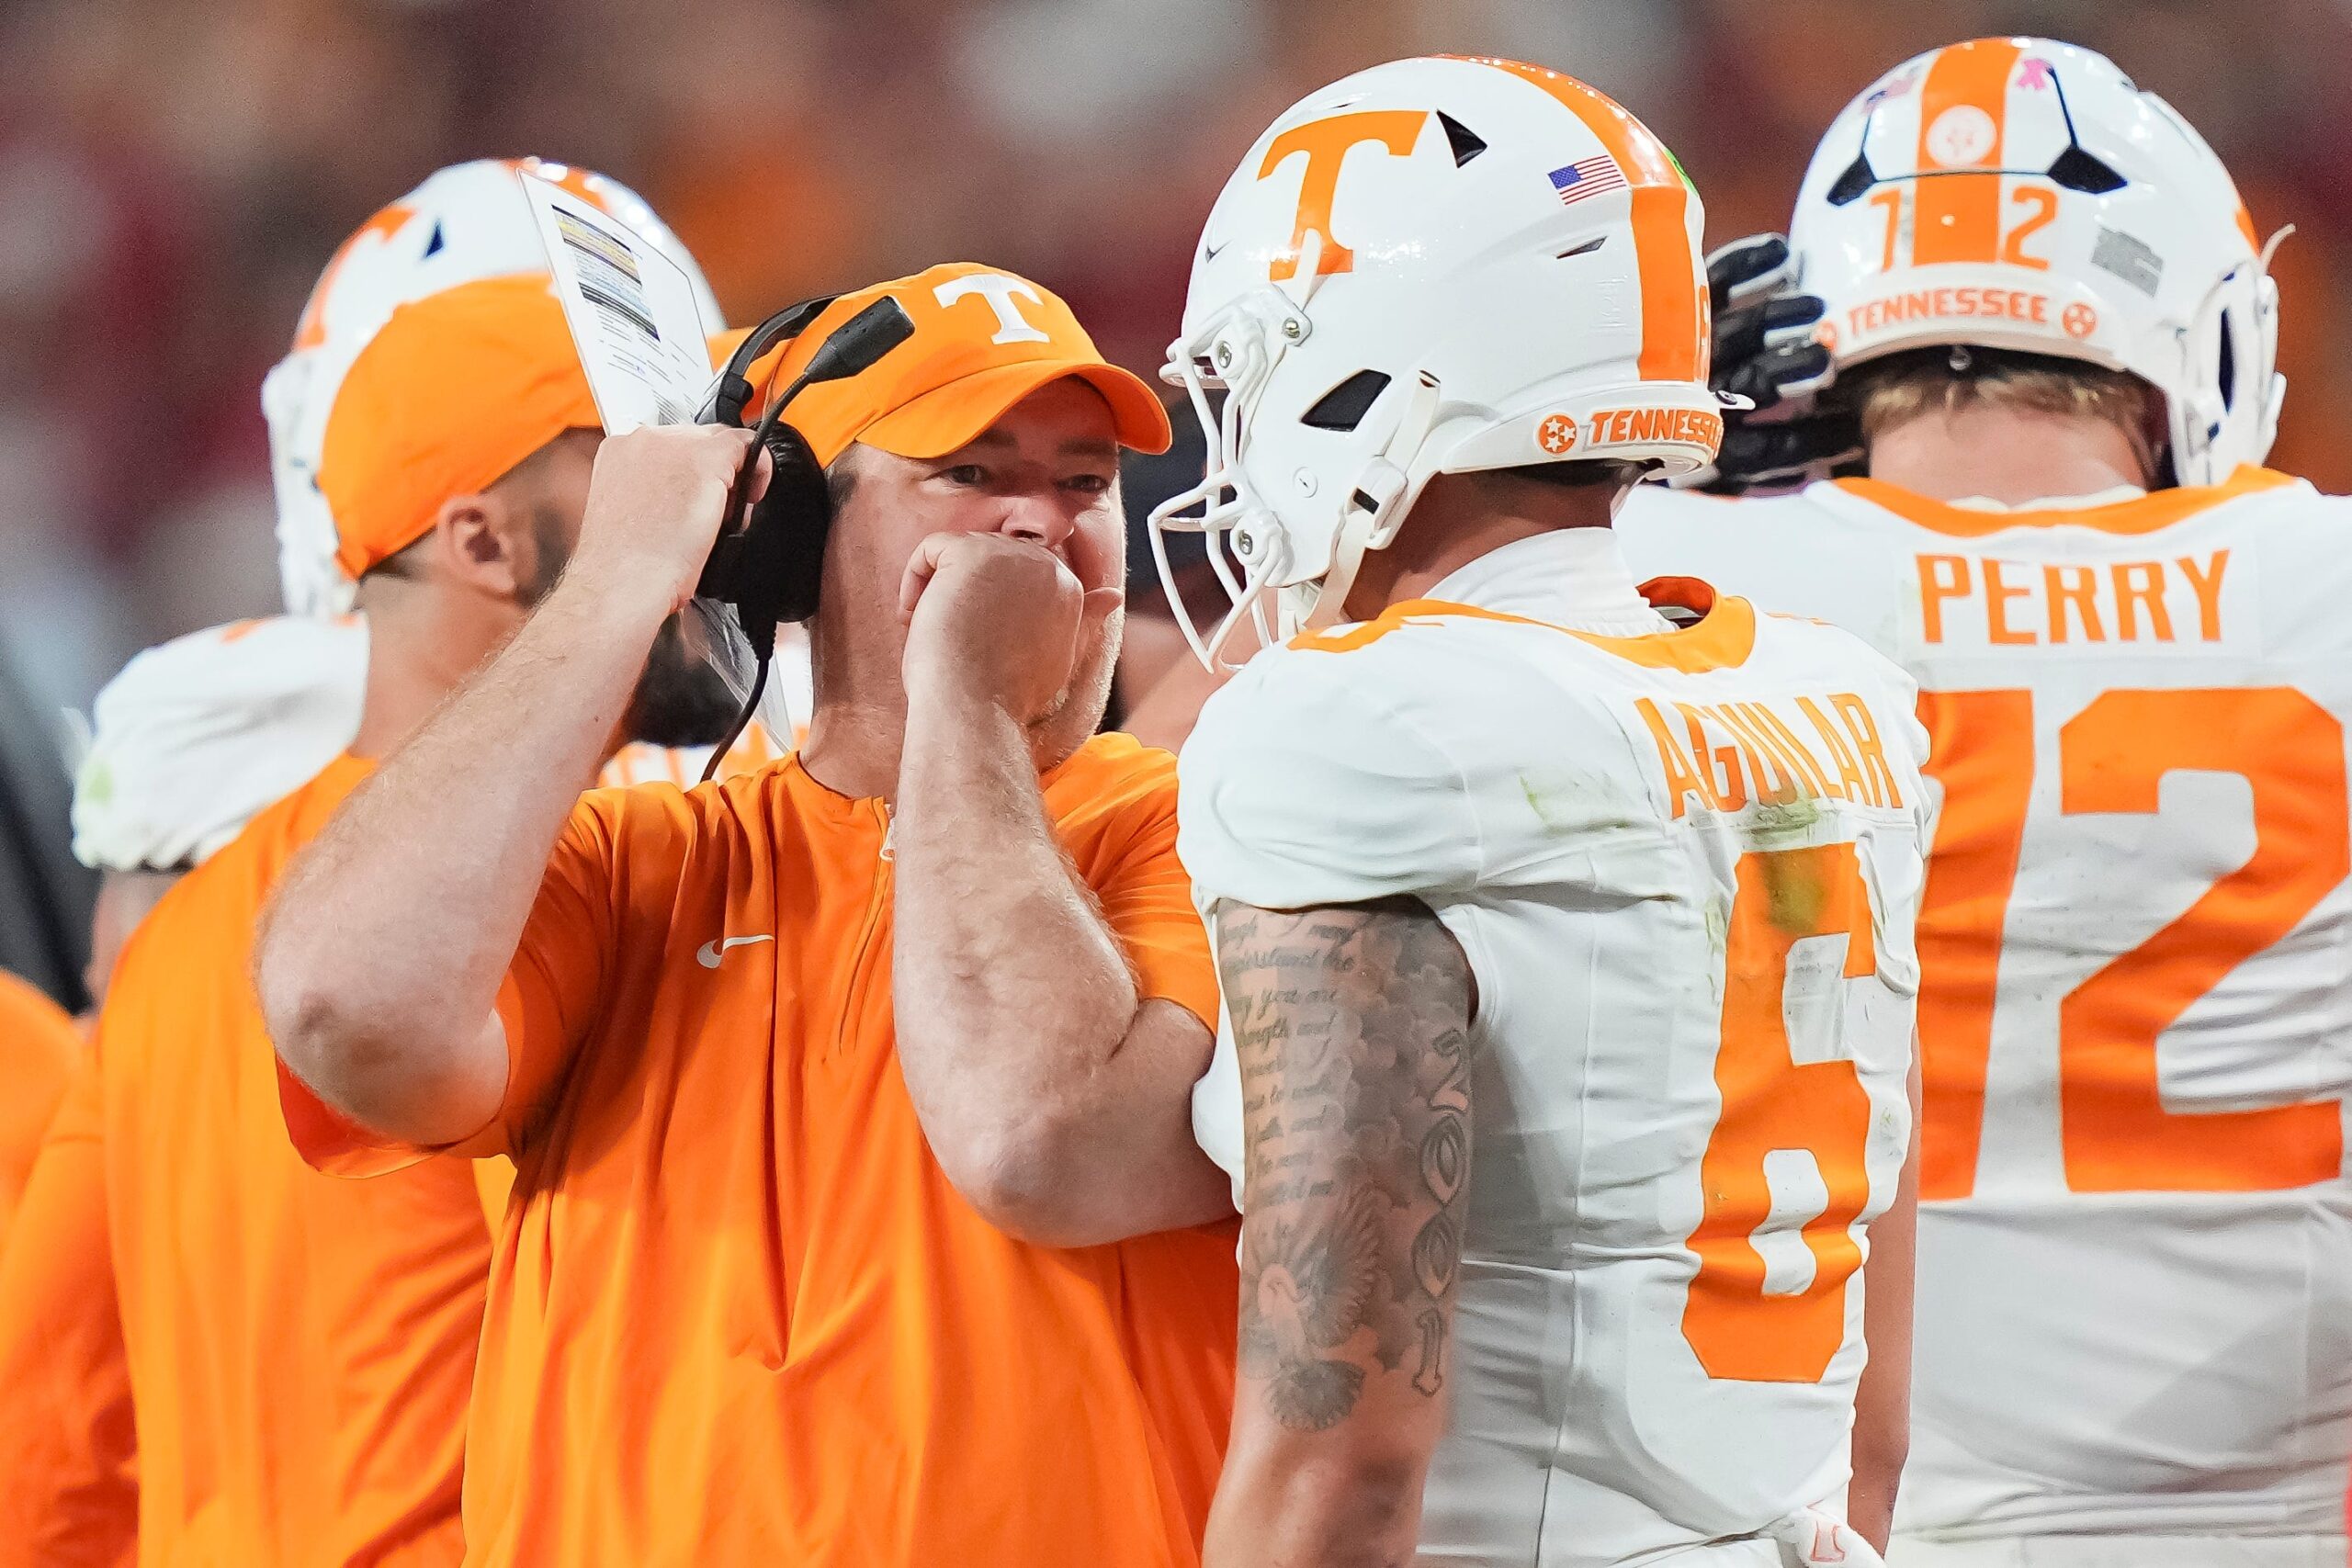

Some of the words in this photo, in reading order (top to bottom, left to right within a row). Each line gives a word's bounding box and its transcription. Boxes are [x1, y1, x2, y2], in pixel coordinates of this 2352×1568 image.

[1256, 109, 1430, 282] T
[1869, 184, 2058, 274] 72
[932, 273, 1051, 345] T
[1847, 287, 2051, 339] TENNESSEE
[1590, 409, 1722, 450] TENNESSE
[1915, 548, 2232, 647] PERRY
[1634, 693, 1904, 819] AGUILAR
[1918, 685, 2352, 1201] 72
[1680, 841, 1876, 1384] 6
